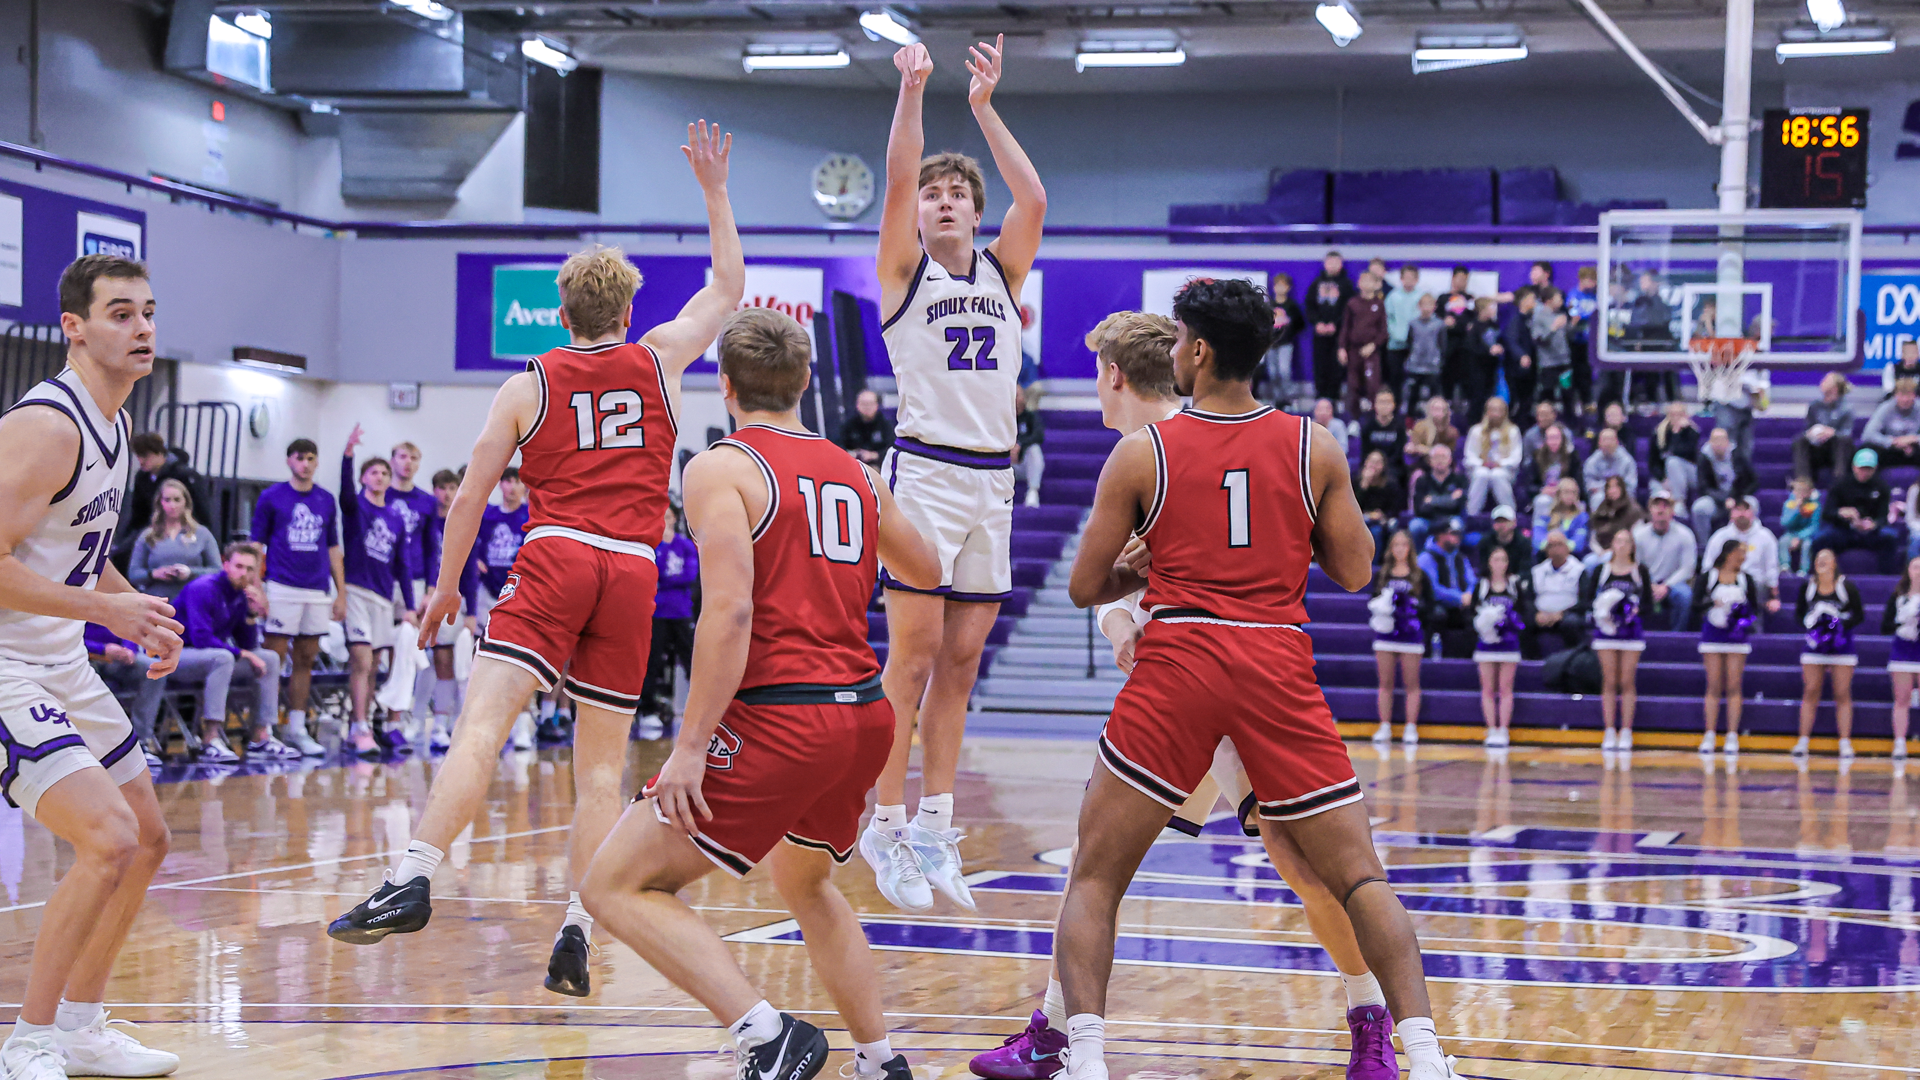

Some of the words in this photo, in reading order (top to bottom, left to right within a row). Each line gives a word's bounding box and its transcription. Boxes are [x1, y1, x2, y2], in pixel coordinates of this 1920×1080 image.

[1782, 115, 1860, 148] 18:56
[1805, 151, 1842, 200] 15
[504, 299, 560, 326] Aver
[926, 297, 968, 325] SIOUX
[971, 297, 1006, 322] FALLS
[944, 326, 998, 370] 22
[568, 388, 645, 451] 12
[797, 475, 864, 565] 10
[1220, 468, 1251, 548] 1
